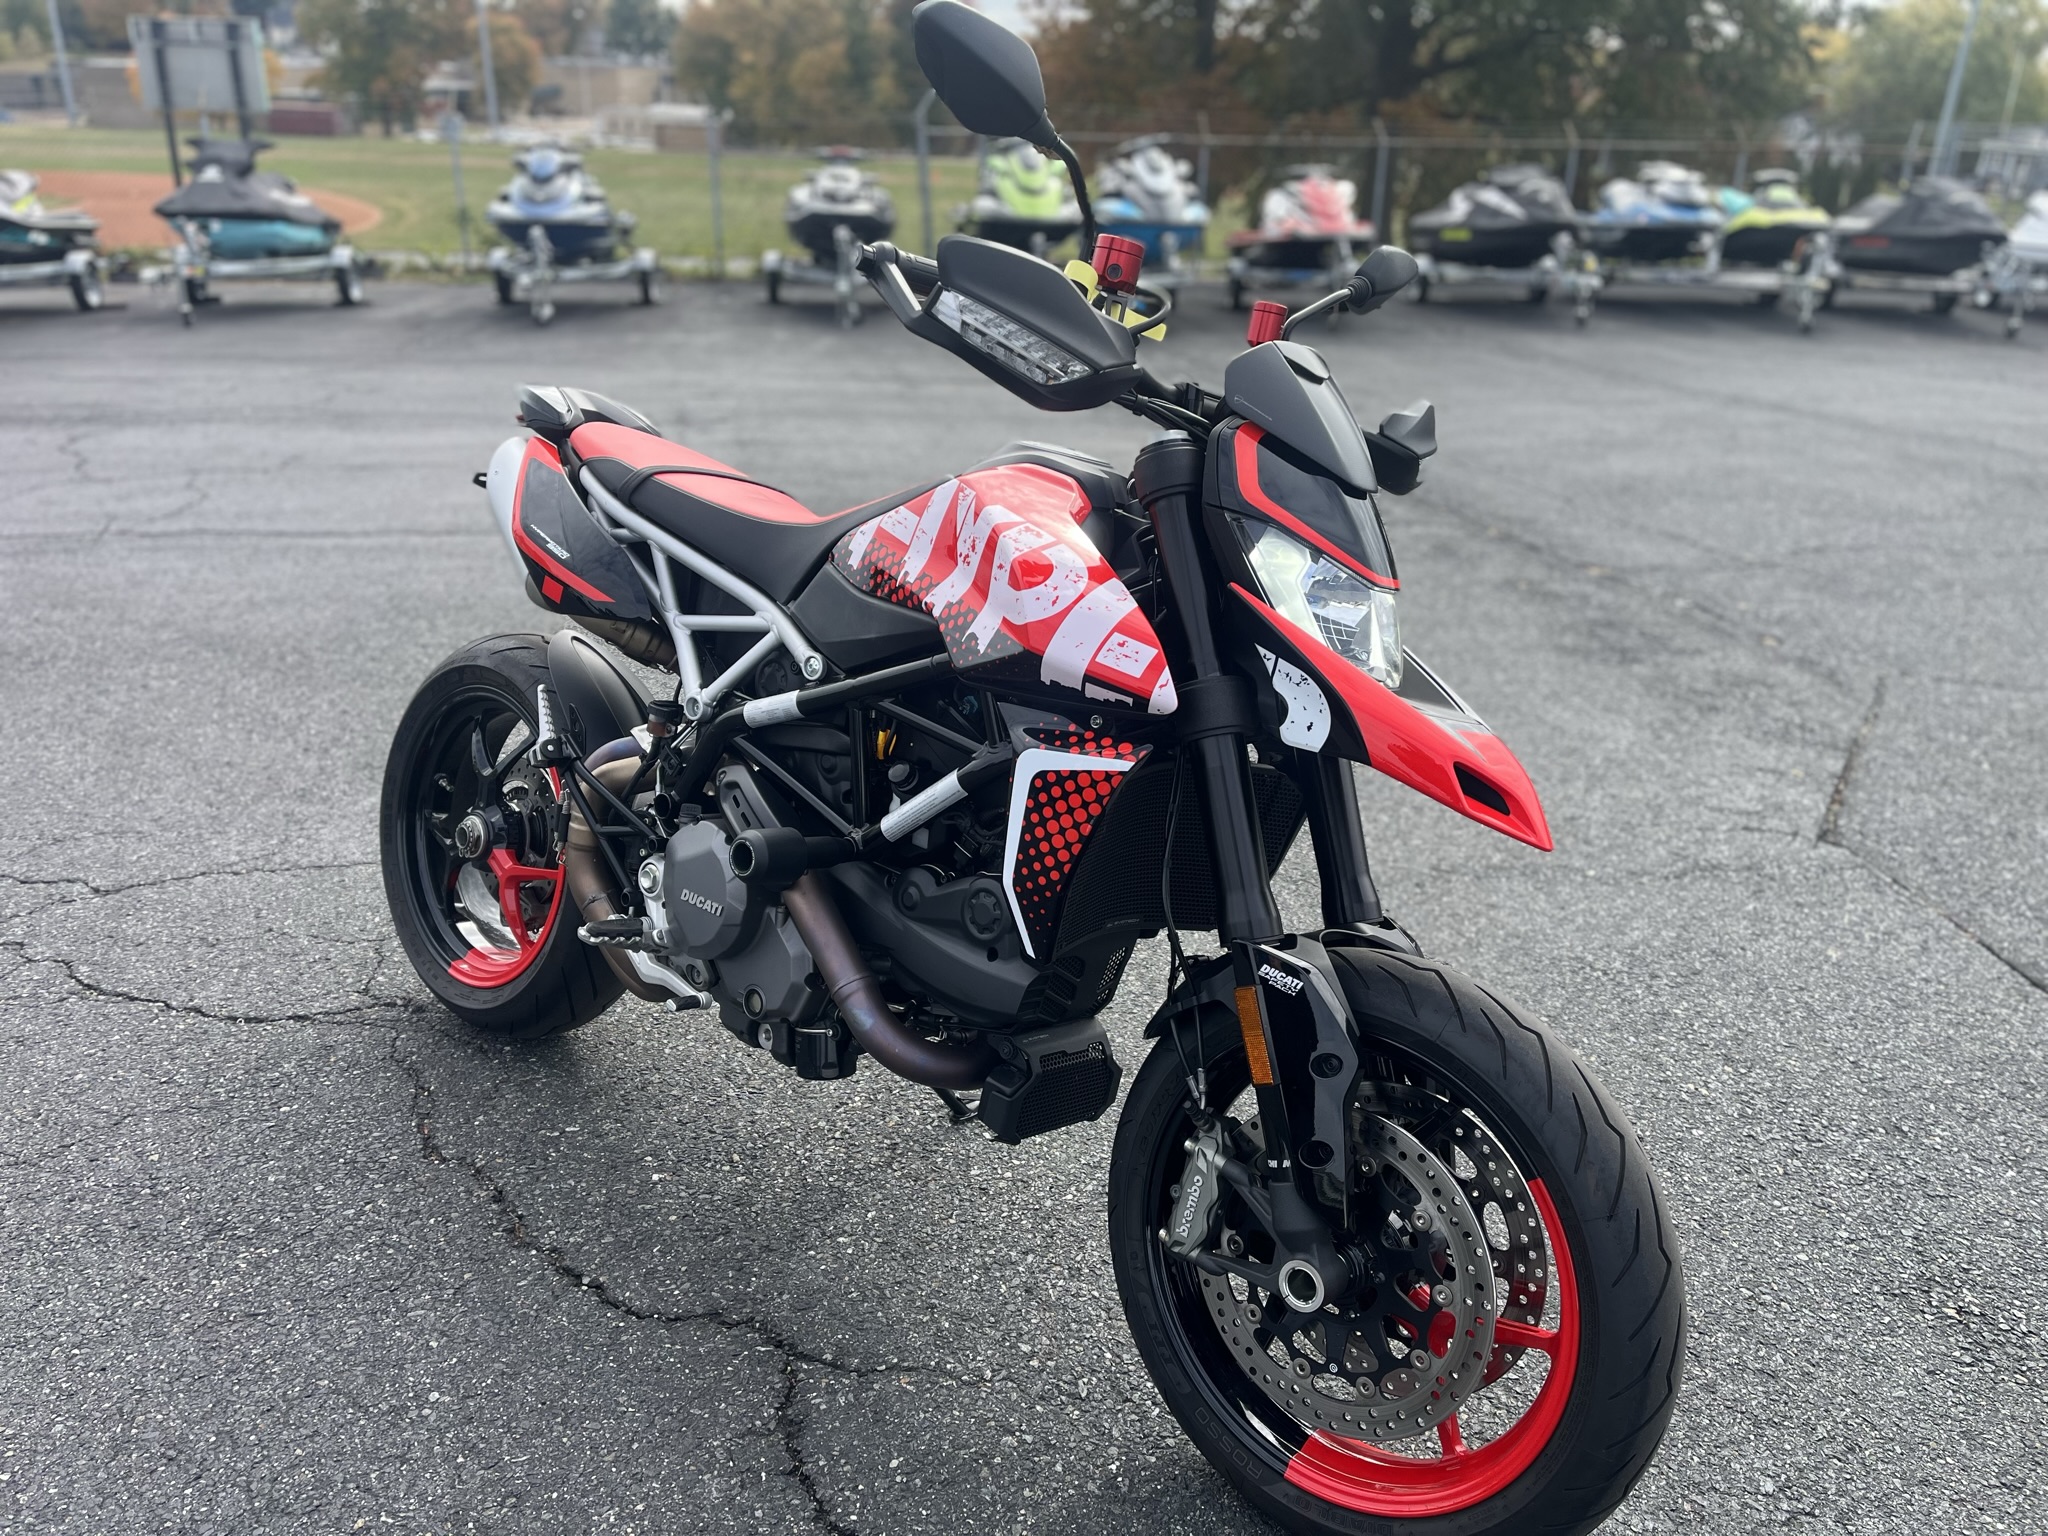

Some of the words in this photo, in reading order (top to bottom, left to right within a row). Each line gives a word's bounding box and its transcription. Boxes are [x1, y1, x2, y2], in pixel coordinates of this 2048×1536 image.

[680, 888, 724, 917] DUCATI
[1260, 963, 1304, 990] DUCATI
[1175, 1175, 1204, 1238] brembo
[1194, 1406, 1264, 1481] ROSSO
